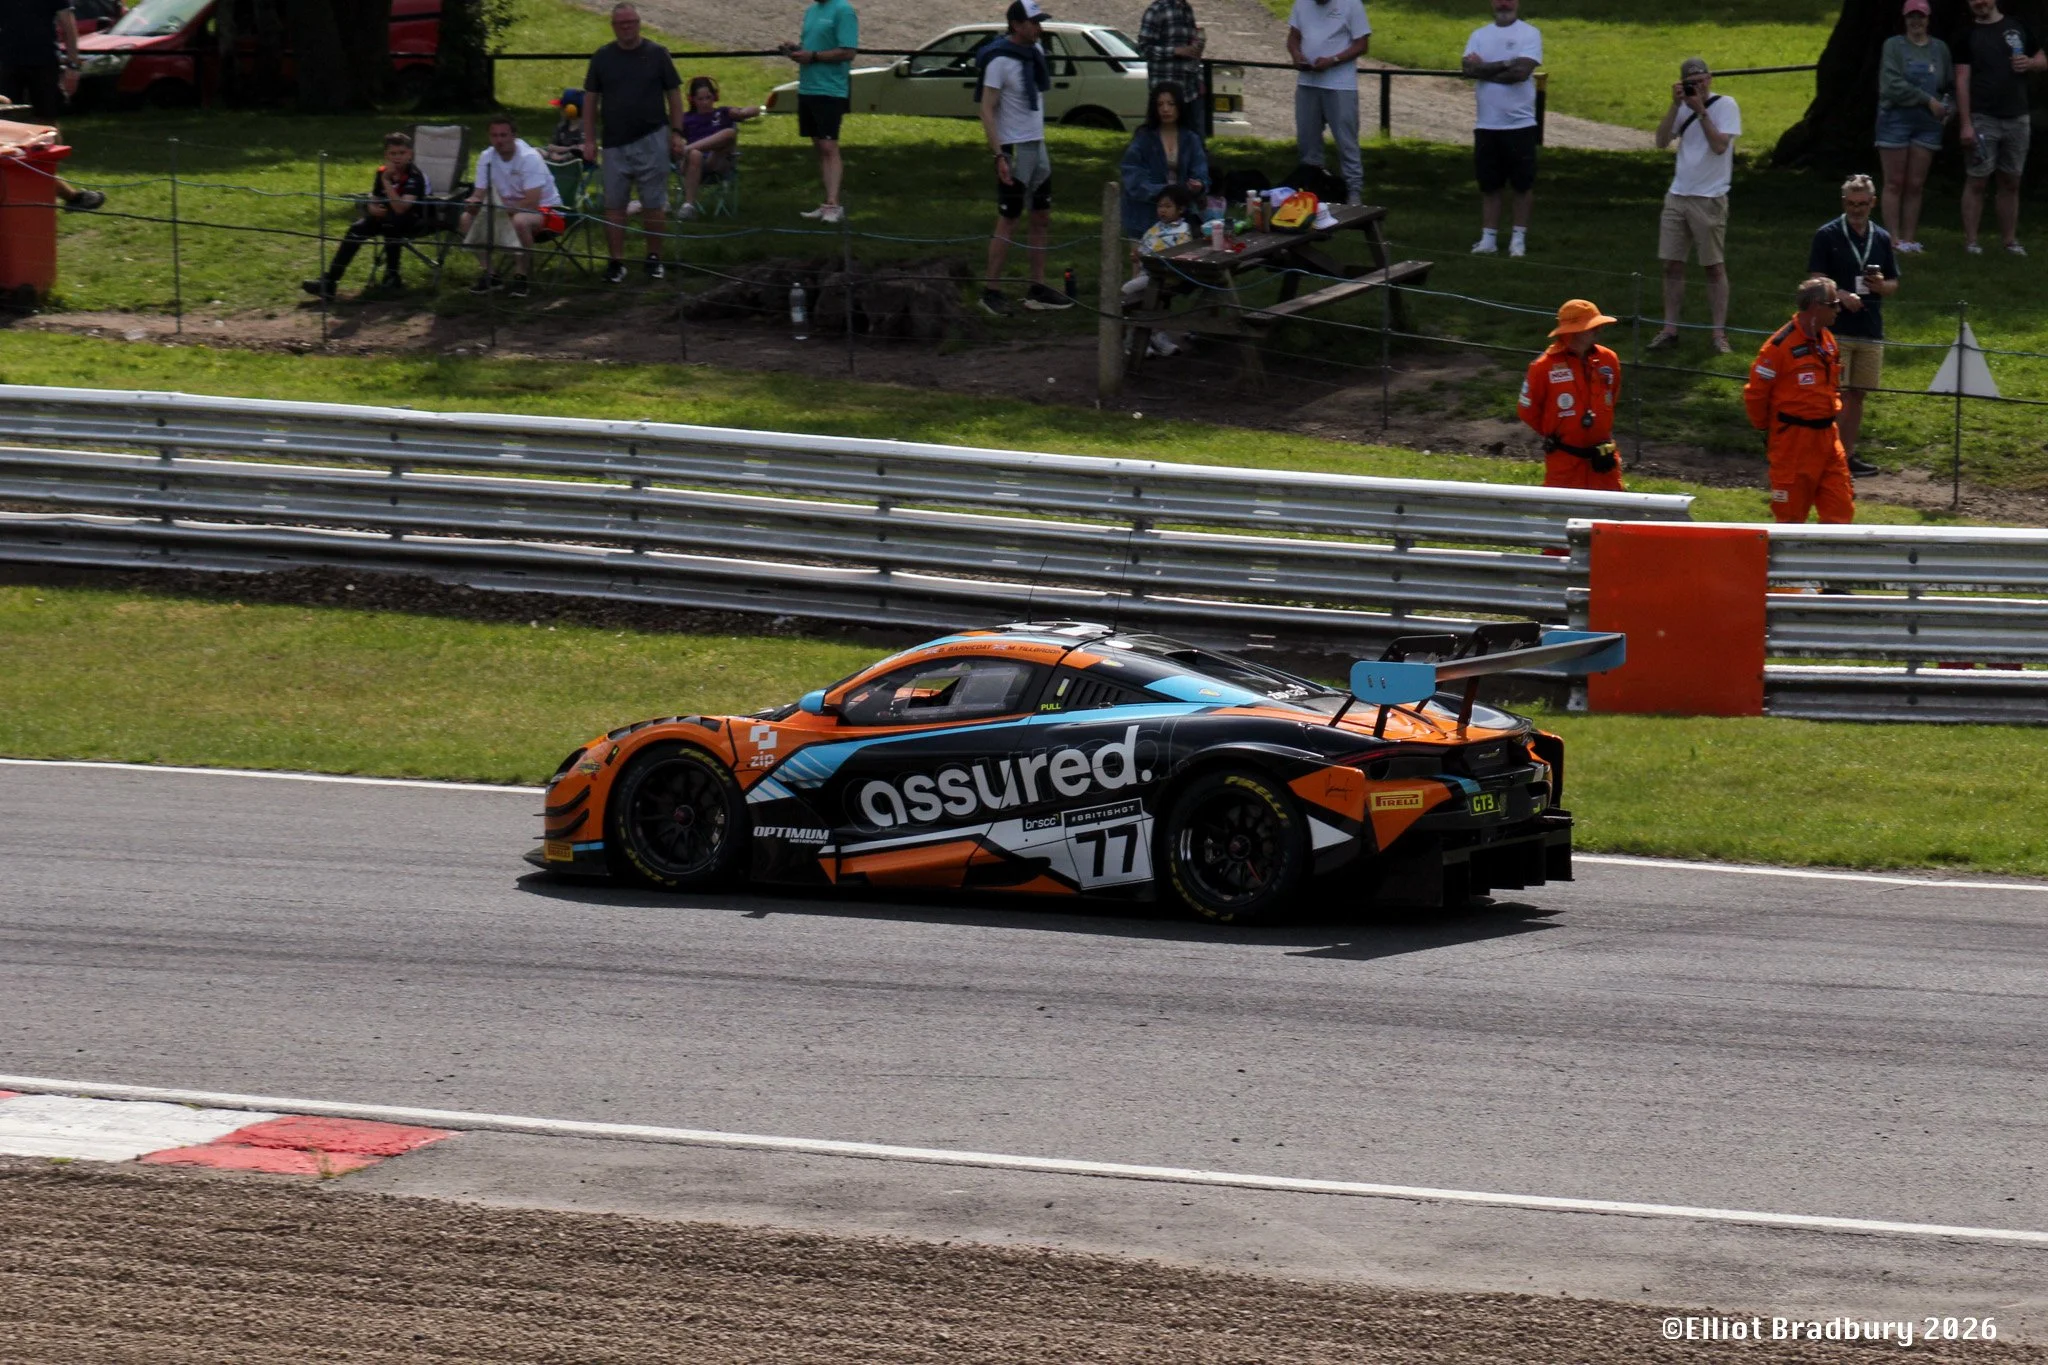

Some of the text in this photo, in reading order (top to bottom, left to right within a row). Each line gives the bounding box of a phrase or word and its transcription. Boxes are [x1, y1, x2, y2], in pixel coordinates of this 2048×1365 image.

[1041, 703, 1061, 711] PULL
[750, 751, 775, 768] zip
[860, 725, 1152, 827] assured.
[1376, 794, 1419, 807] PIRELLI
[1472, 793, 1495, 812] GT3
[1071, 805, 1136, 822] #BRITISHGT
[1025, 817, 1056, 830] brscc
[753, 826, 830, 840] OPTIMUM
[1075, 823, 1138, 878] 77
